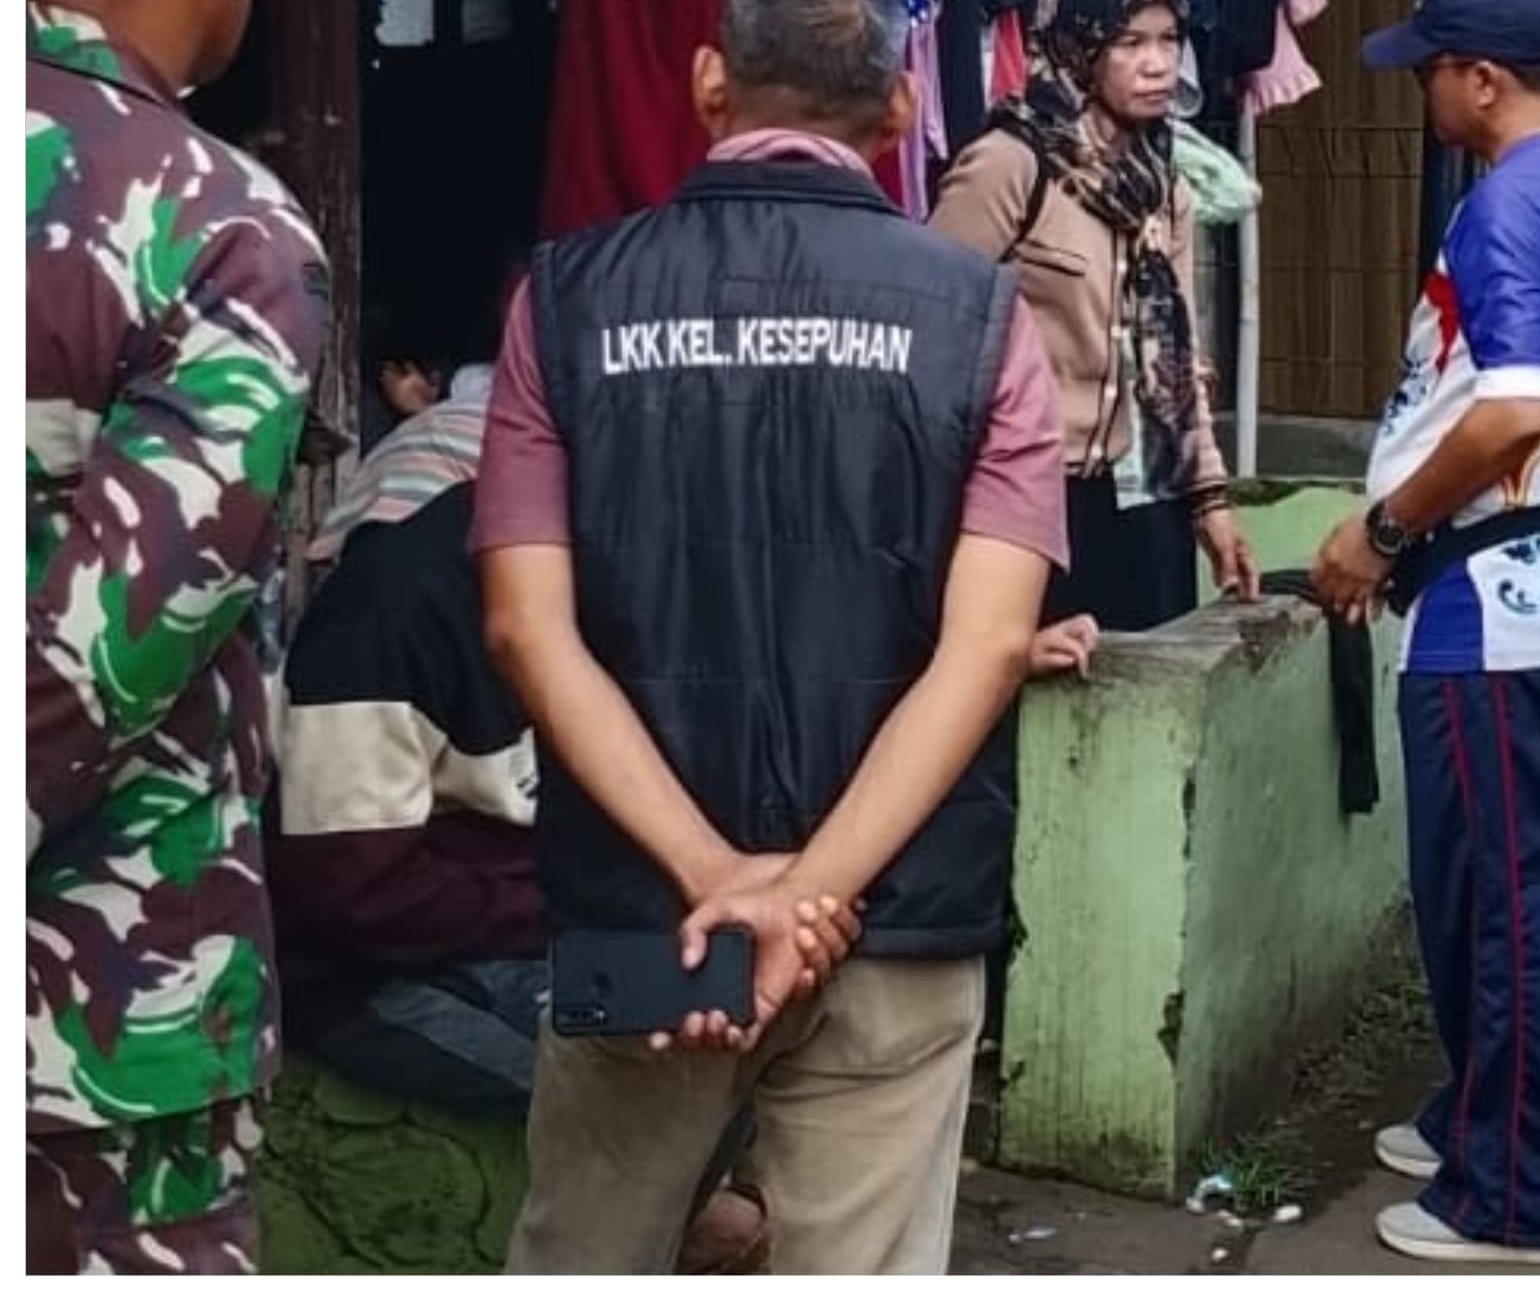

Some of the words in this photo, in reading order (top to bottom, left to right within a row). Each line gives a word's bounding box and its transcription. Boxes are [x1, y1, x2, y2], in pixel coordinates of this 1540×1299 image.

[602, 321, 665, 375] LKK
[666, 317, 734, 366] KEL.
[736, 316, 913, 374] KESEPUHAN
